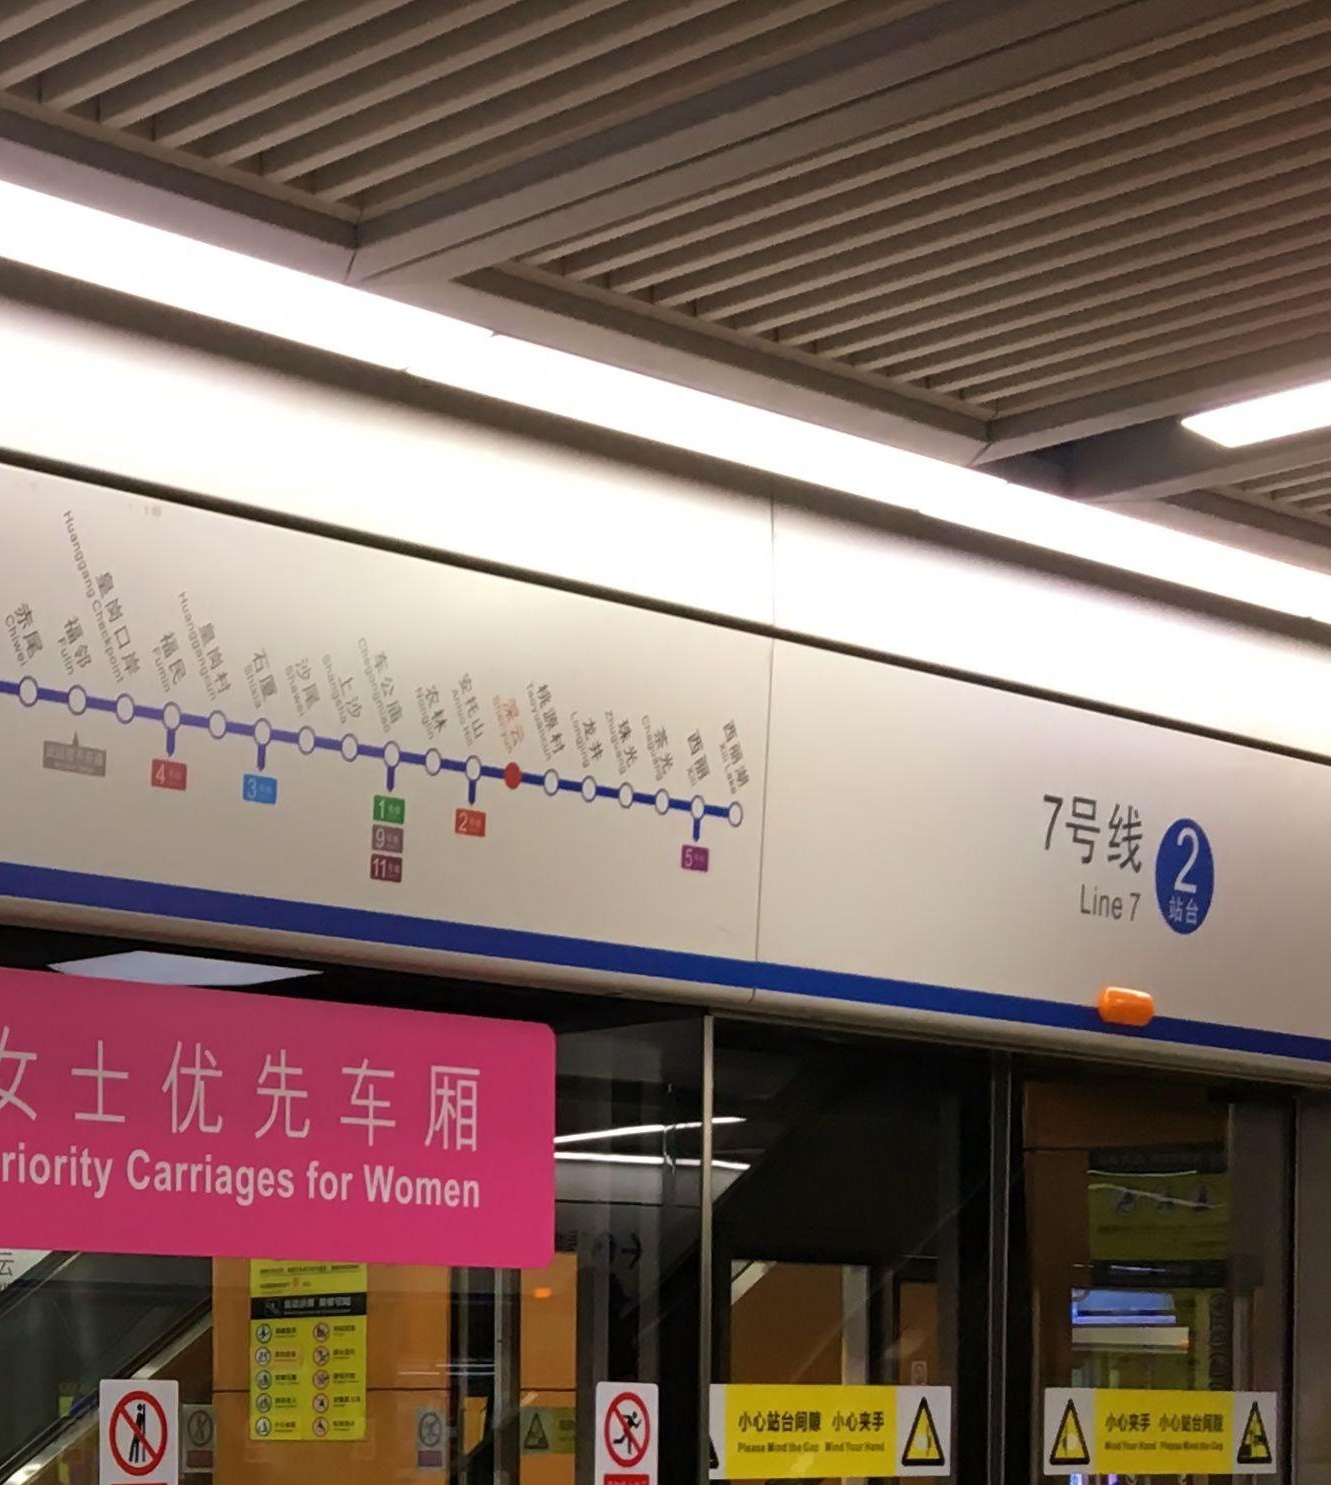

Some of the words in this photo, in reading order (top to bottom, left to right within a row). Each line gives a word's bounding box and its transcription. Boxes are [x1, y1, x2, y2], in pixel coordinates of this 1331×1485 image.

[62, 510, 96, 599] Huanggang
[91, 600, 124, 685] Checkpoint
[5, 614, 28, 667] Chiwei
[14, 602, 43, 660] 赤尾
[58, 637, 75, 676] Fulin
[152, 646, 171, 693] Fumin
[160, 631, 187, 686] 福民
[1044, 794, 1142, 873] 7号线
[1174, 827, 1199, 893] 2
[1081, 884, 1122, 920] Line
[1130, 893, 1141, 921] 7
[1169, 896, 1199, 925] 站台
[127, 1149, 295, 1207] Carriages
[307, 1160, 353, 1201] for
[364, 1164, 480, 1208] Women
[738, 1411, 821, 1432] 小心站台间隙
[832, 1411, 884, 1432] 小心夹手
[1105, 1412, 1151, 1432] 小心夹手
